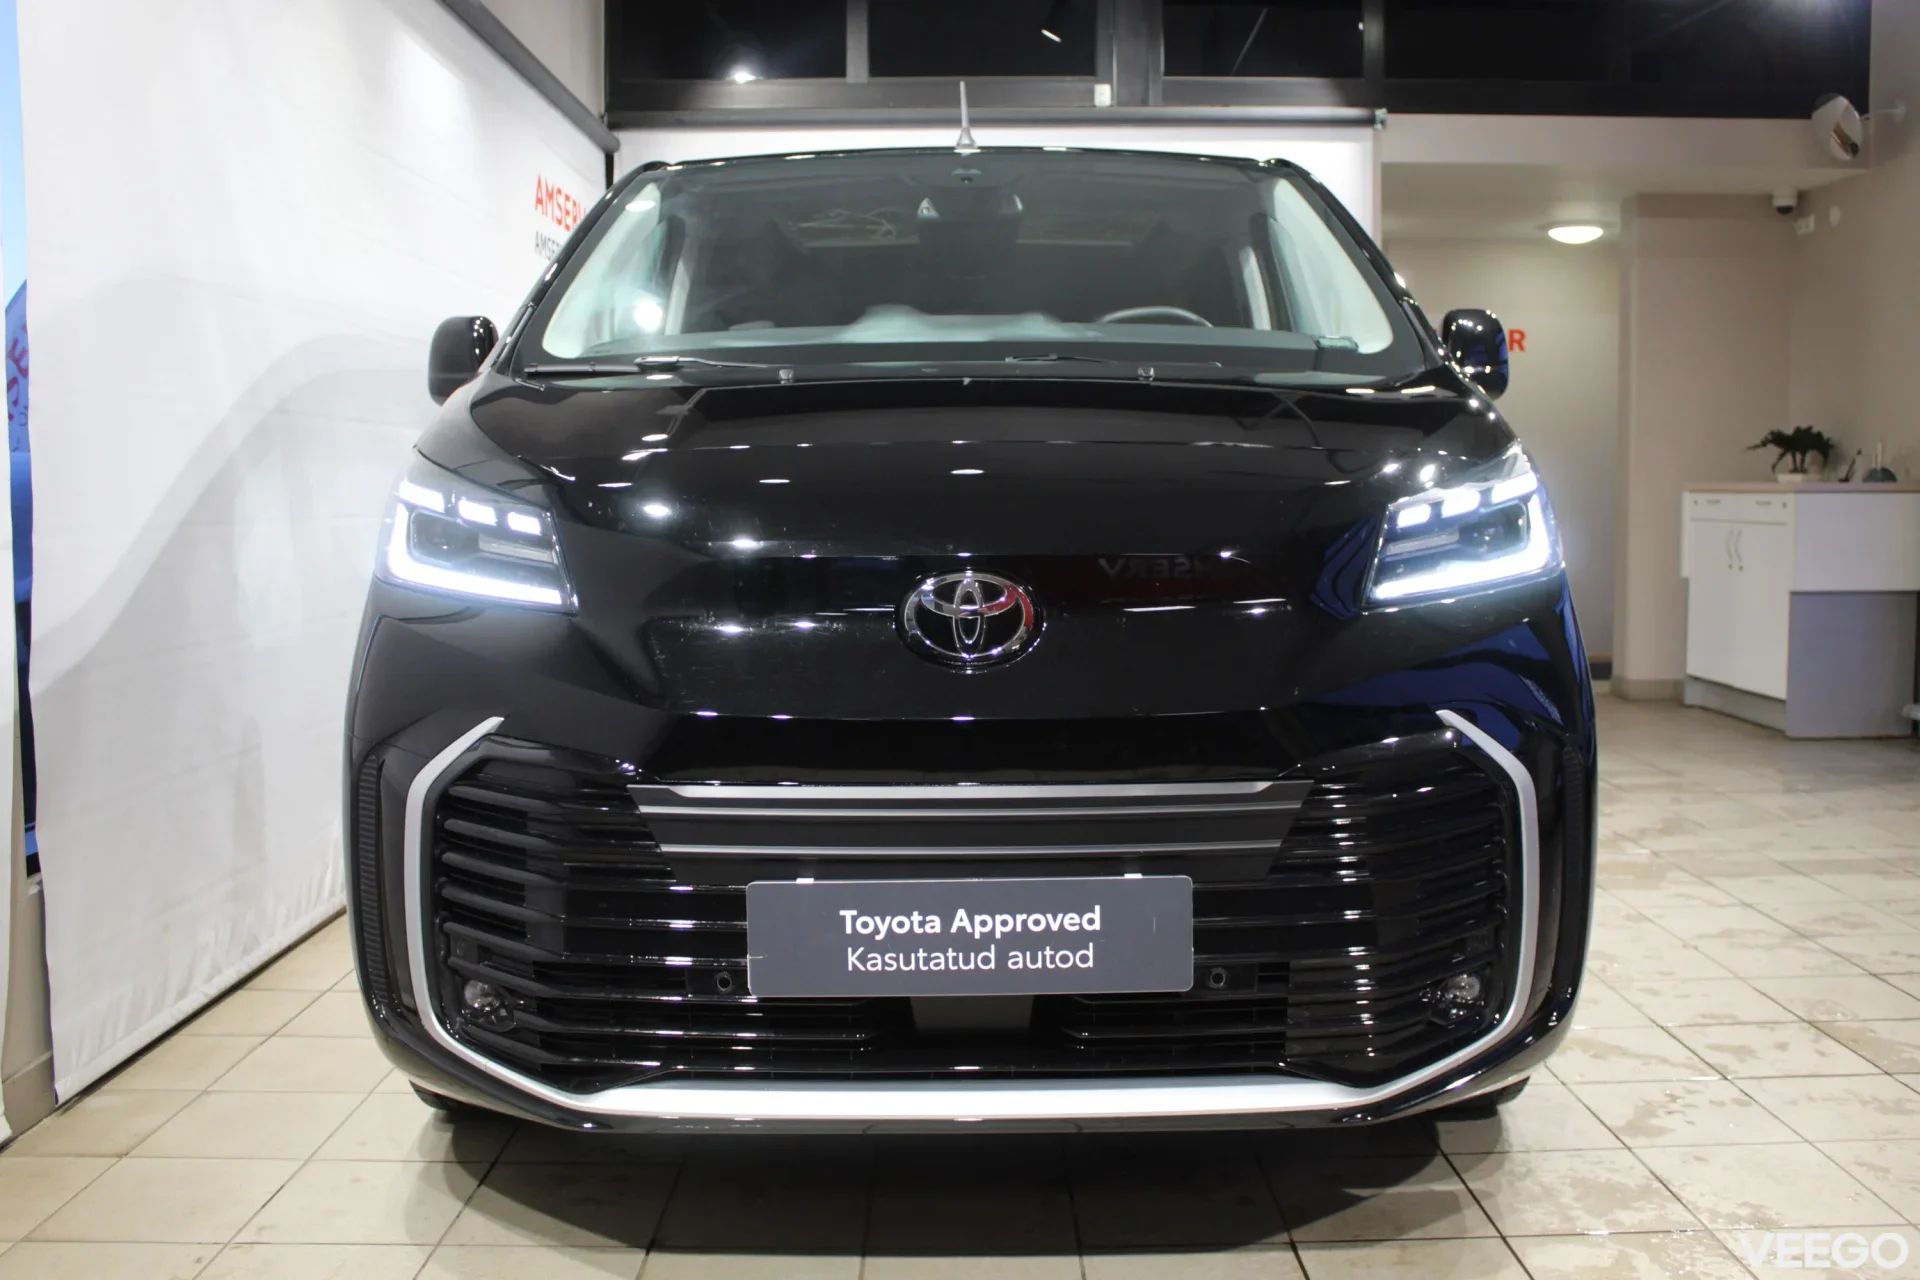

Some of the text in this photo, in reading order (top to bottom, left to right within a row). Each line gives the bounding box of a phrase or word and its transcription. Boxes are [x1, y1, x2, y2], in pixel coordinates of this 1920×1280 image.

[535, 173, 586, 232] AMSER
[839, 905, 1101, 940] Toyota Approved
[847, 942, 1094, 972] Kasutatud autod
